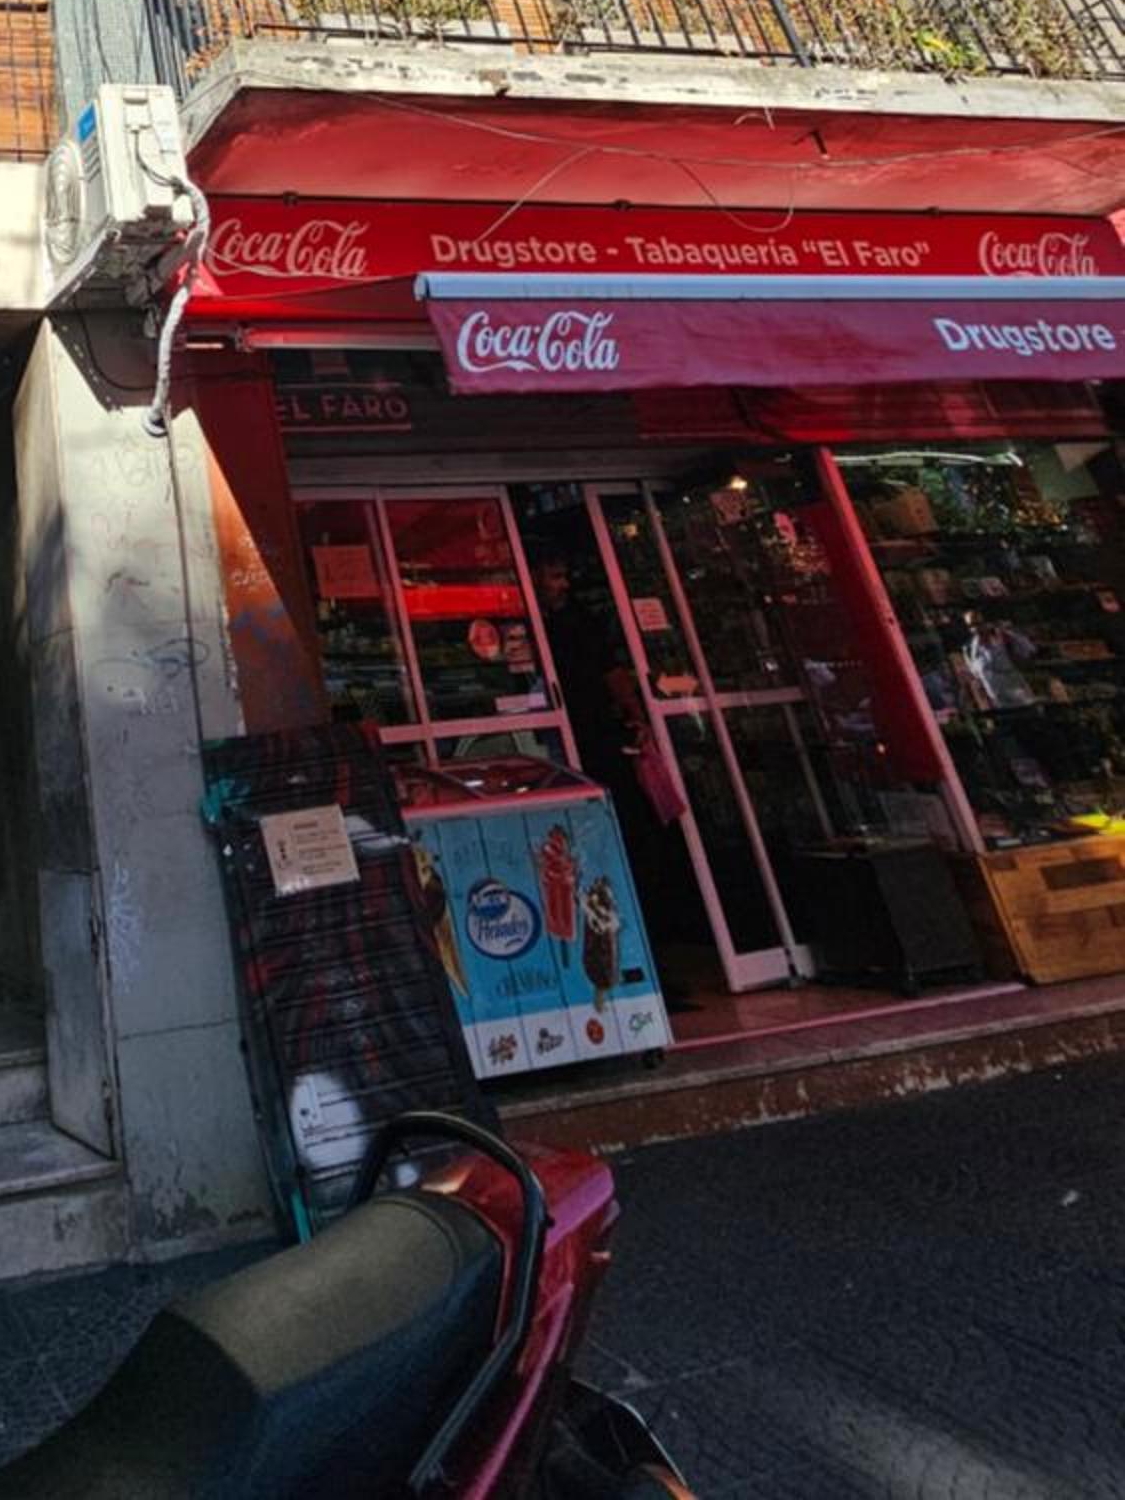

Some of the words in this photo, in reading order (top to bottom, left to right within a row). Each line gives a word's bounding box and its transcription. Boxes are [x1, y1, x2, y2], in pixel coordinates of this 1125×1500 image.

[206, 218, 371, 277] Coca-Cola
[430, 234, 597, 268] Drugstore
[457, 311, 620, 373] Coca-Cola
[933, 318, 1116, 356] Drugstore
[319, 393, 409, 419] FARO
